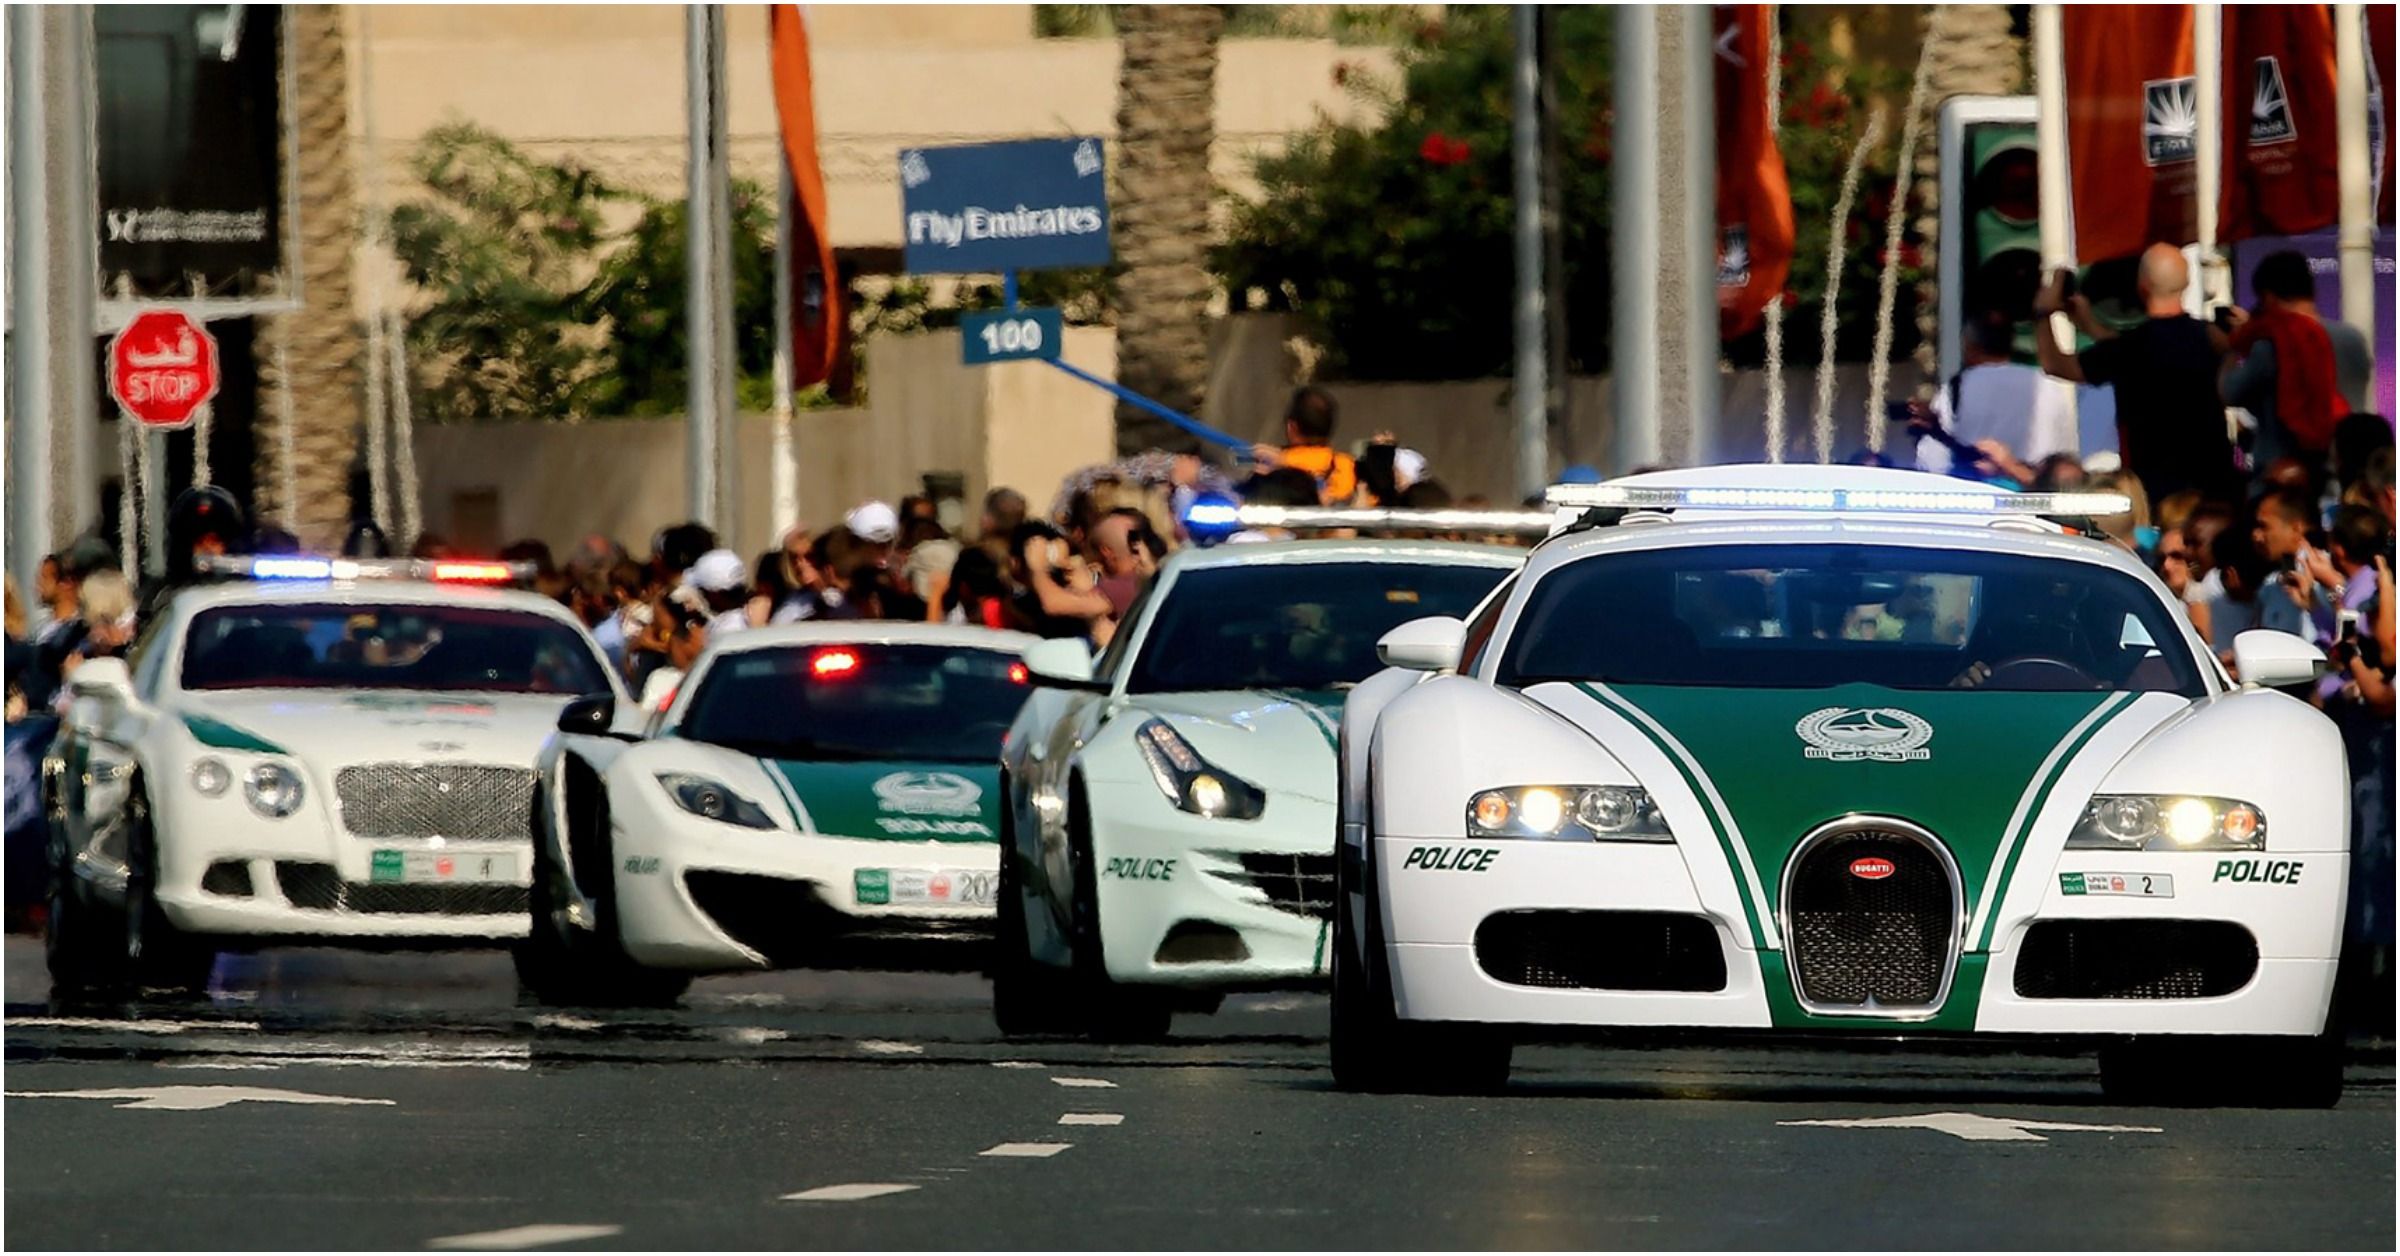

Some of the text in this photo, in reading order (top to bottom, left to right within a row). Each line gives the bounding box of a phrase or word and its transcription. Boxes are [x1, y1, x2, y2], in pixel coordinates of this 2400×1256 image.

[909, 204, 1102, 248] Fly Emirates
[980, 318, 1043, 354] 100
[126, 370, 200, 404] STOP
[1102, 858, 1177, 881] POLICE
[1403, 847, 1501, 872] POLICE
[1855, 864, 1889, 873] BUGATTI
[2212, 860, 2304, 884] POLICE
[2142, 875, 2153, 894] 2
